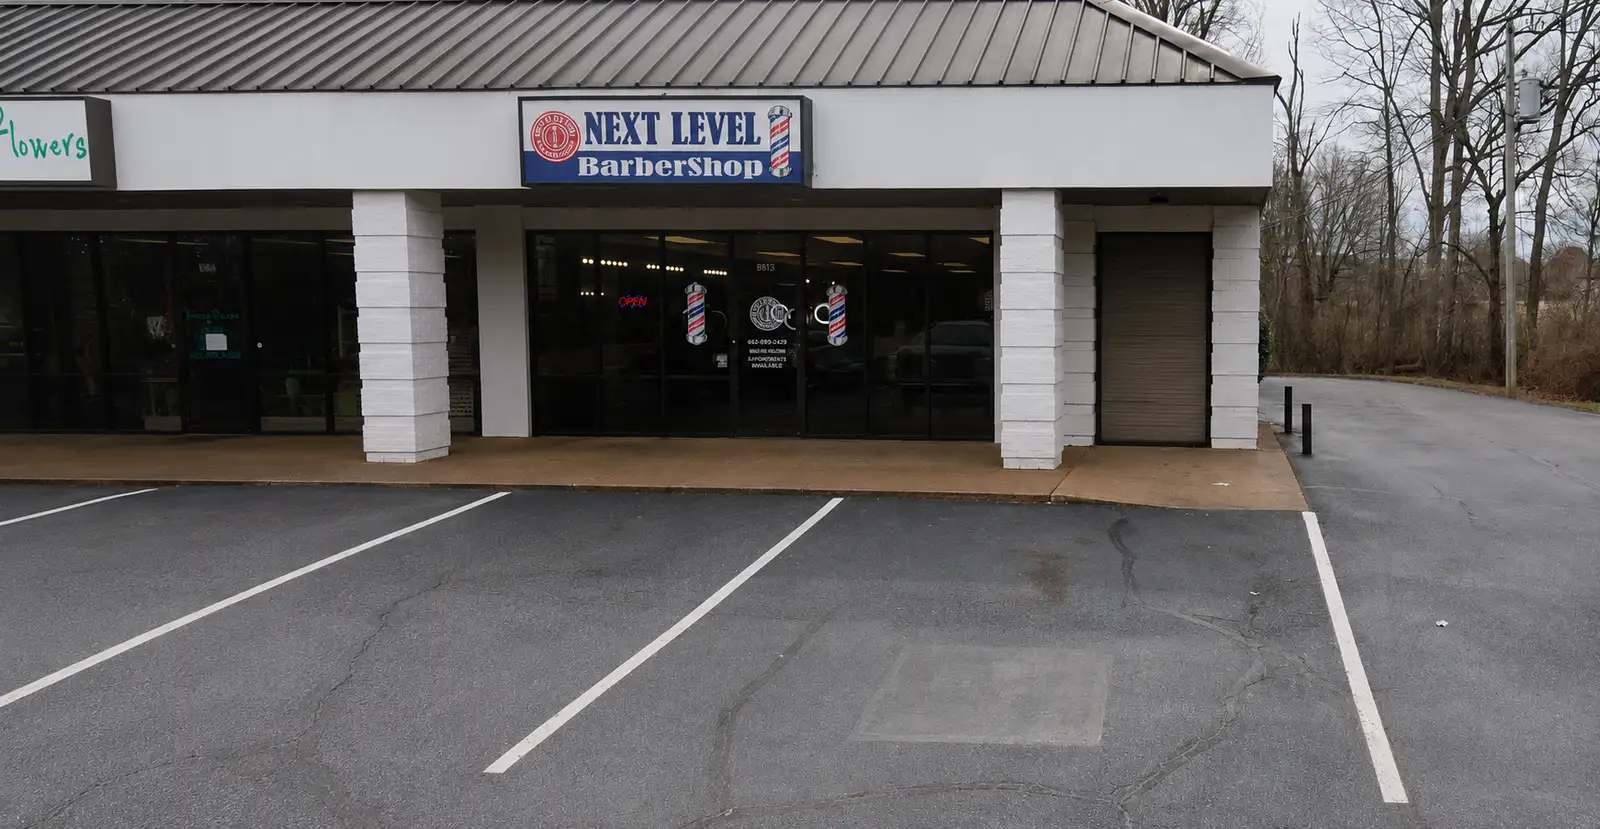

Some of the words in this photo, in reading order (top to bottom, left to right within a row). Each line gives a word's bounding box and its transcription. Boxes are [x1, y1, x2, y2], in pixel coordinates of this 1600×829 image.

[584, 111, 660, 145] NEXT
[671, 111, 761, 145] LEVEL
[578, 156, 763, 179] BarberShop
[618, 296, 648, 306] OPEN
